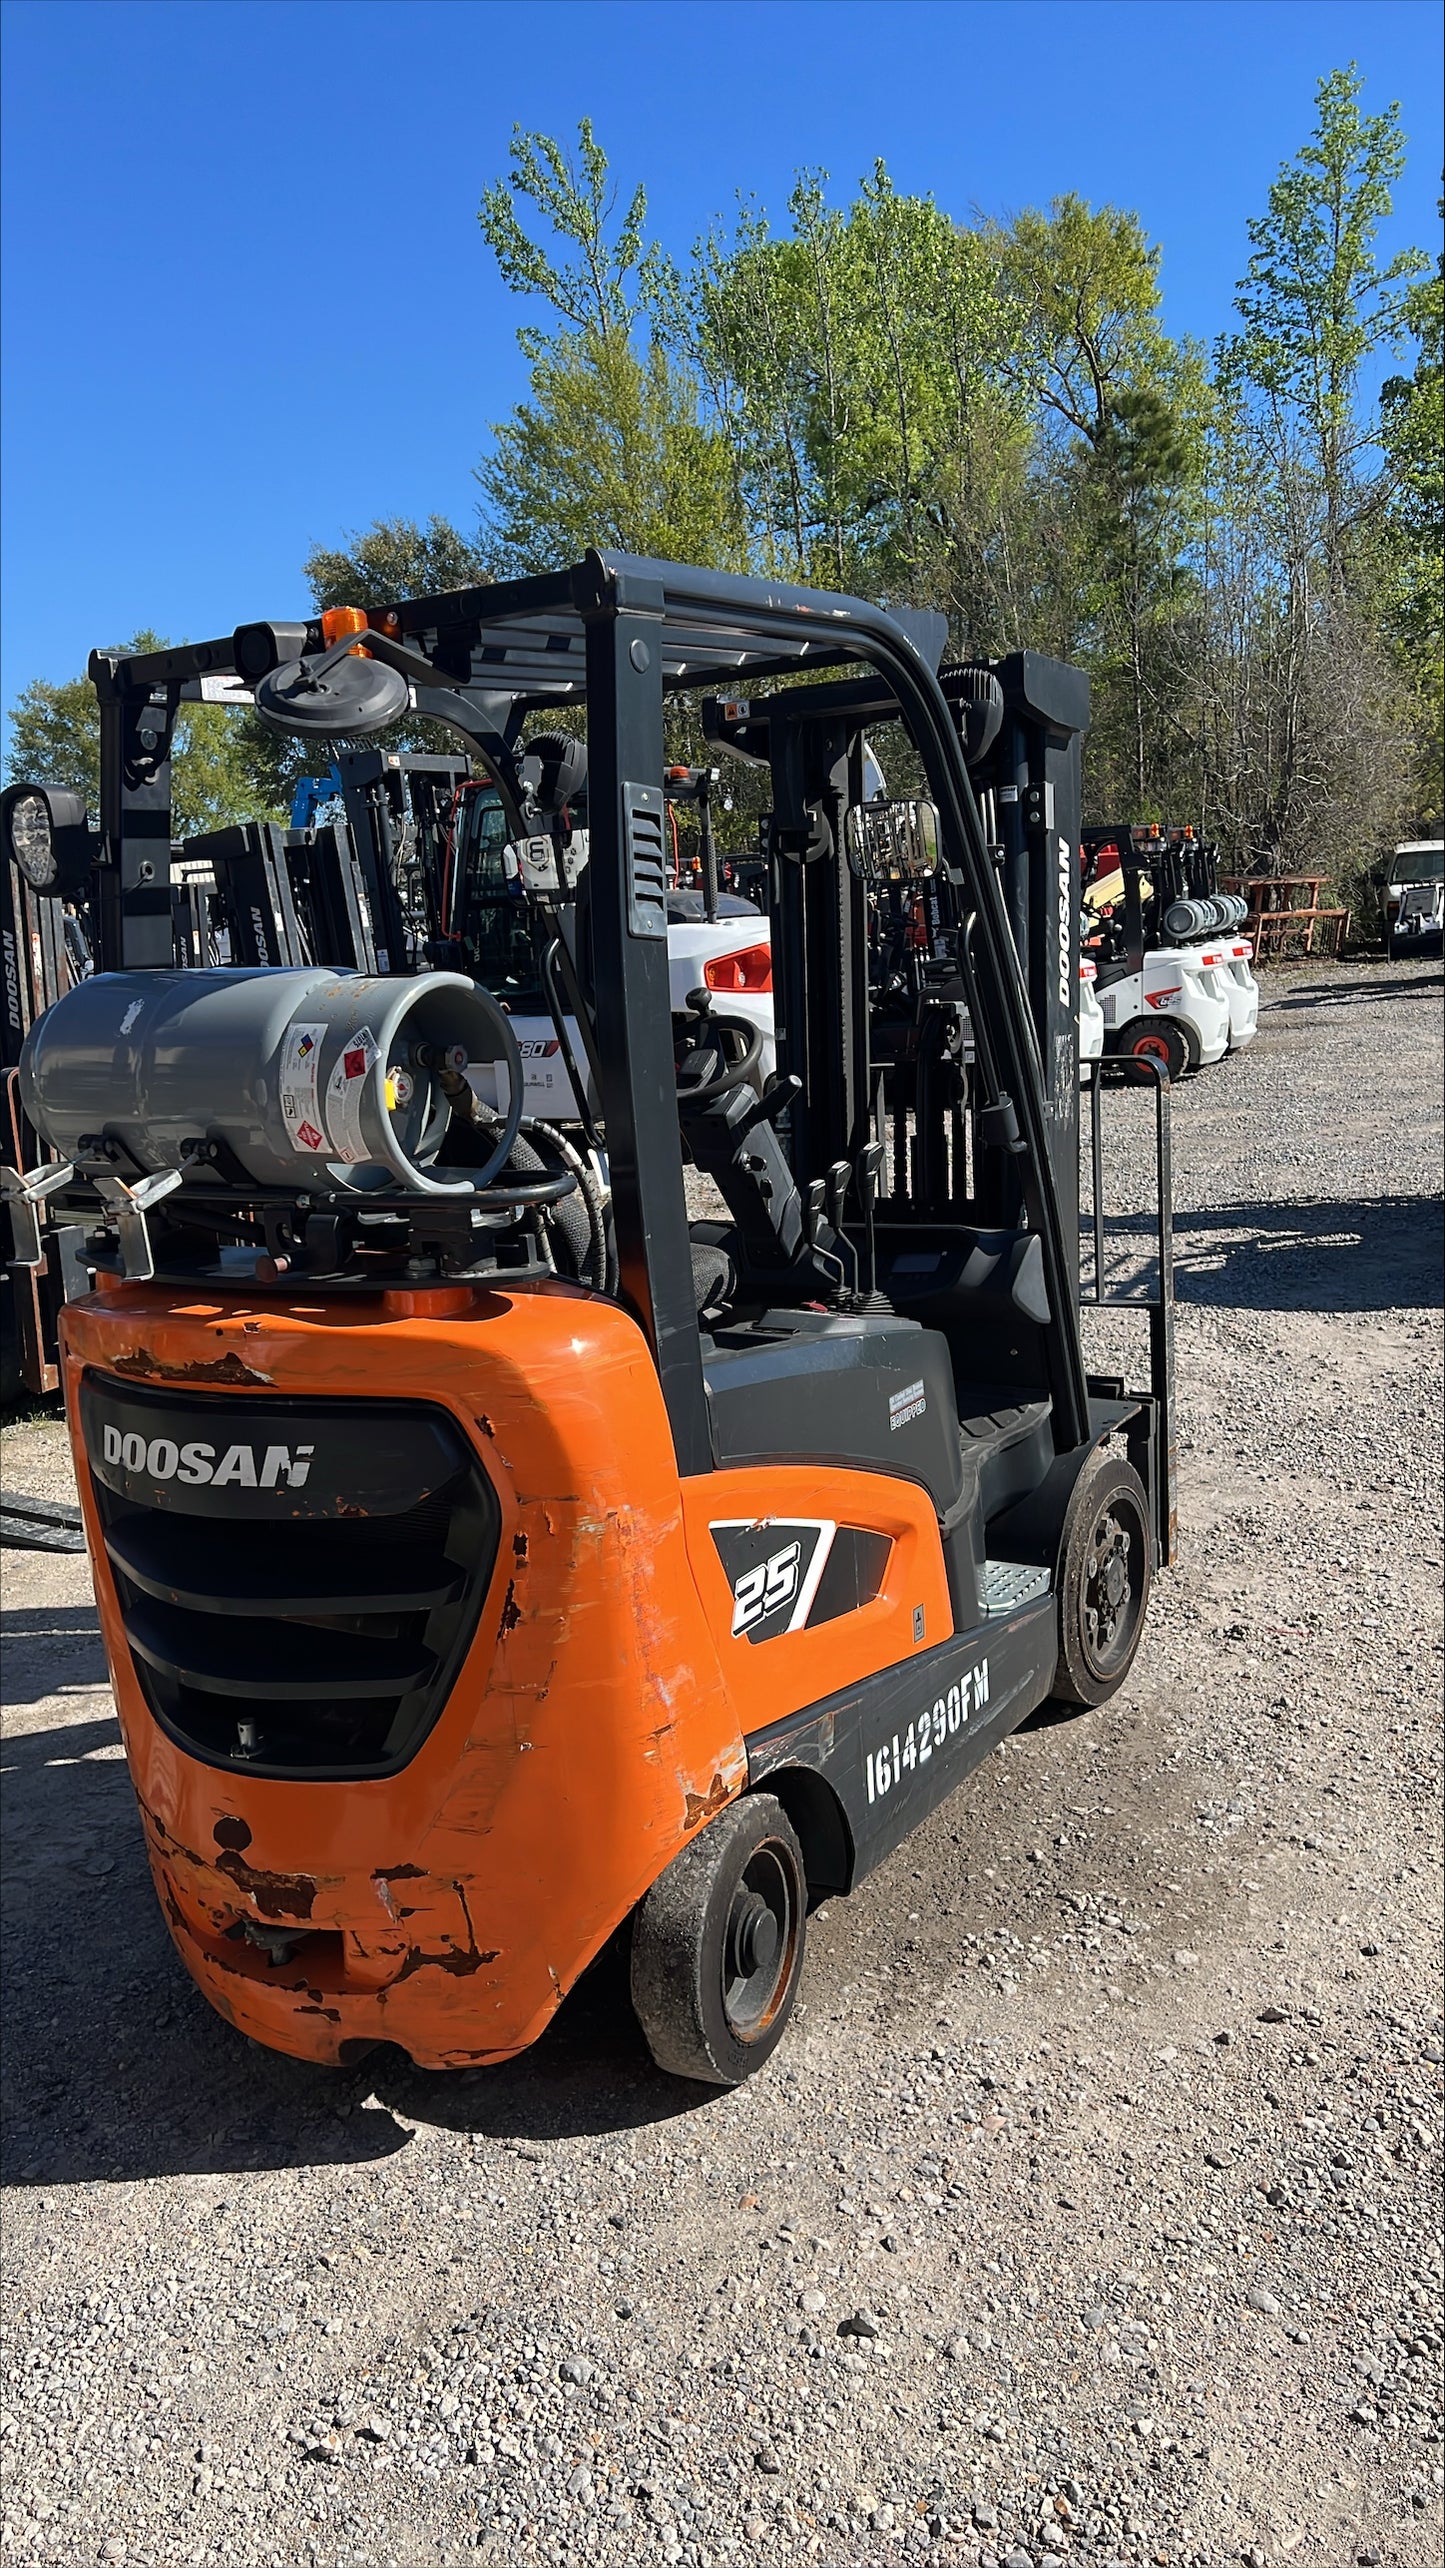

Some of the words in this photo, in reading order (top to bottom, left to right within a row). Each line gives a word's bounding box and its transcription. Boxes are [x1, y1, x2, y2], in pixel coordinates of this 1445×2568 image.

[250, 906, 270, 967] OSAN
[929, 896, 940, 925] Bobcat
[1059, 837, 1070, 1008] DOOSAN
[2, 929, 20, 1030] DOOSAN
[104, 1424, 315, 1488] DOOSAN
[731, 1541, 801, 1639] 25
[866, 1657, 990, 1804] 1614290FM
